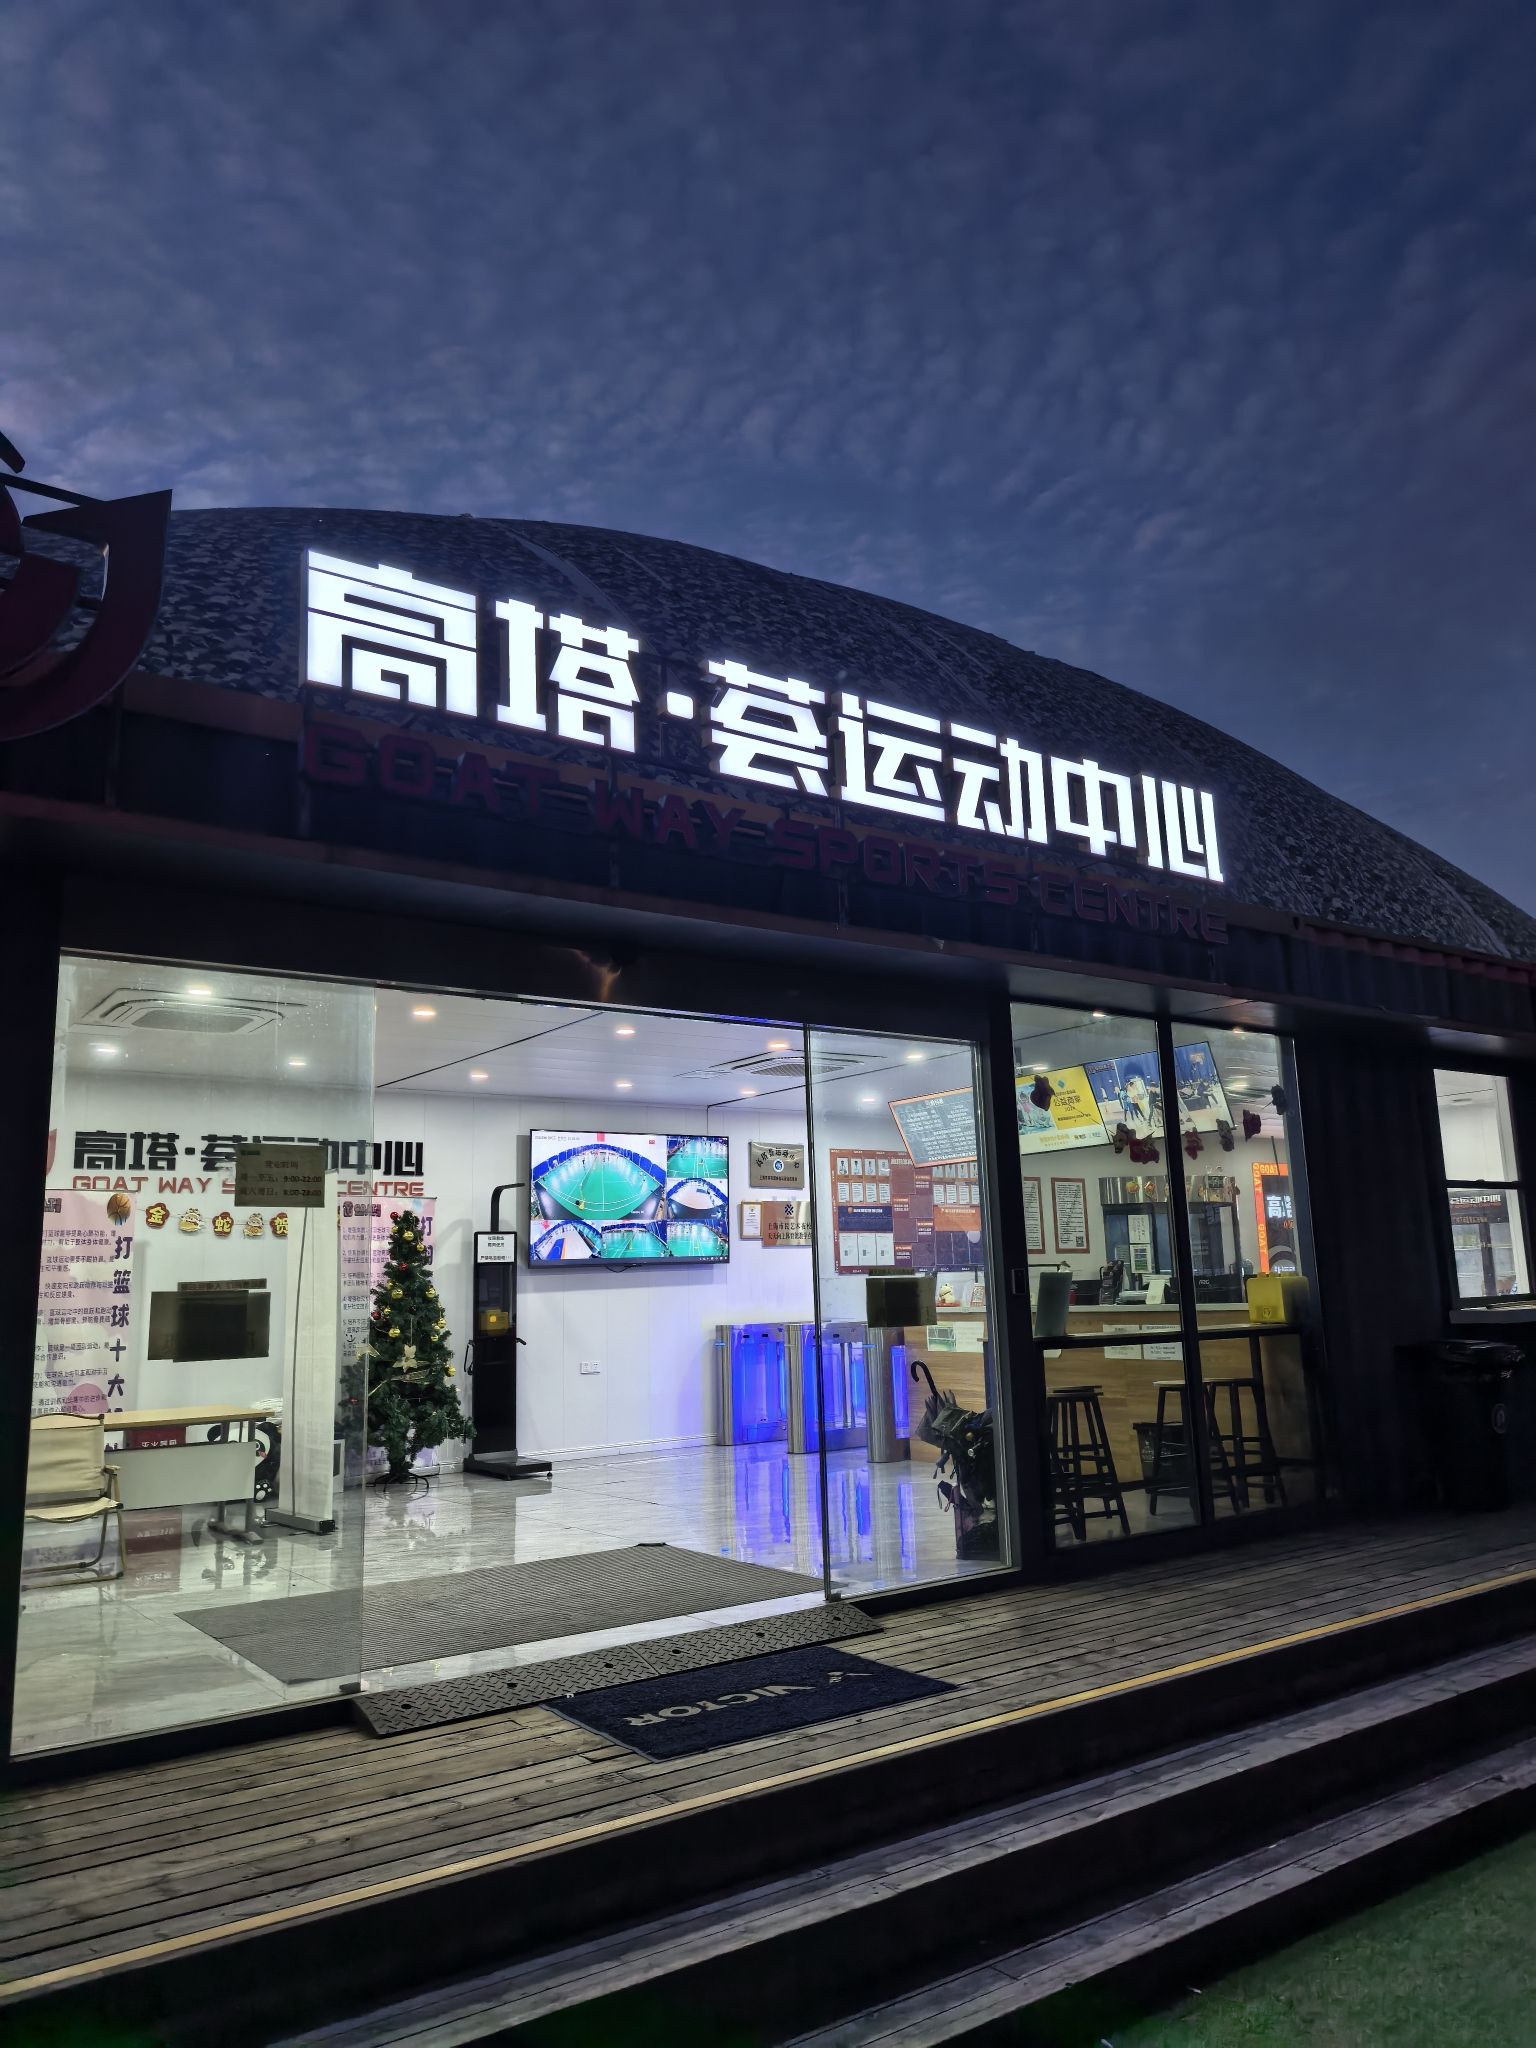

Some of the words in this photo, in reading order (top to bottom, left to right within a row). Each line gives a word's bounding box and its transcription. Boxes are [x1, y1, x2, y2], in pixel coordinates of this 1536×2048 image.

[307, 549, 1224, 883] 高塔·荟运动中心
[304, 725, 560, 818] GOAT
[590, 779, 748, 854] WAY
[769, 820, 1020, 906] SPORTS
[1036, 873, 1230, 945] CENTRE
[73, 1130, 424, 1177] 高塔·荟中心
[1259, 1164, 1279, 1176] GOAT
[159, 1177, 212, 1193] WAY
[149, 1207, 167, 1225] 金
[215, 1218, 231, 1233] 蛇
[107, 1236, 133, 1412] 打篮球十大
[623, 1685, 817, 1727] VICTOR
